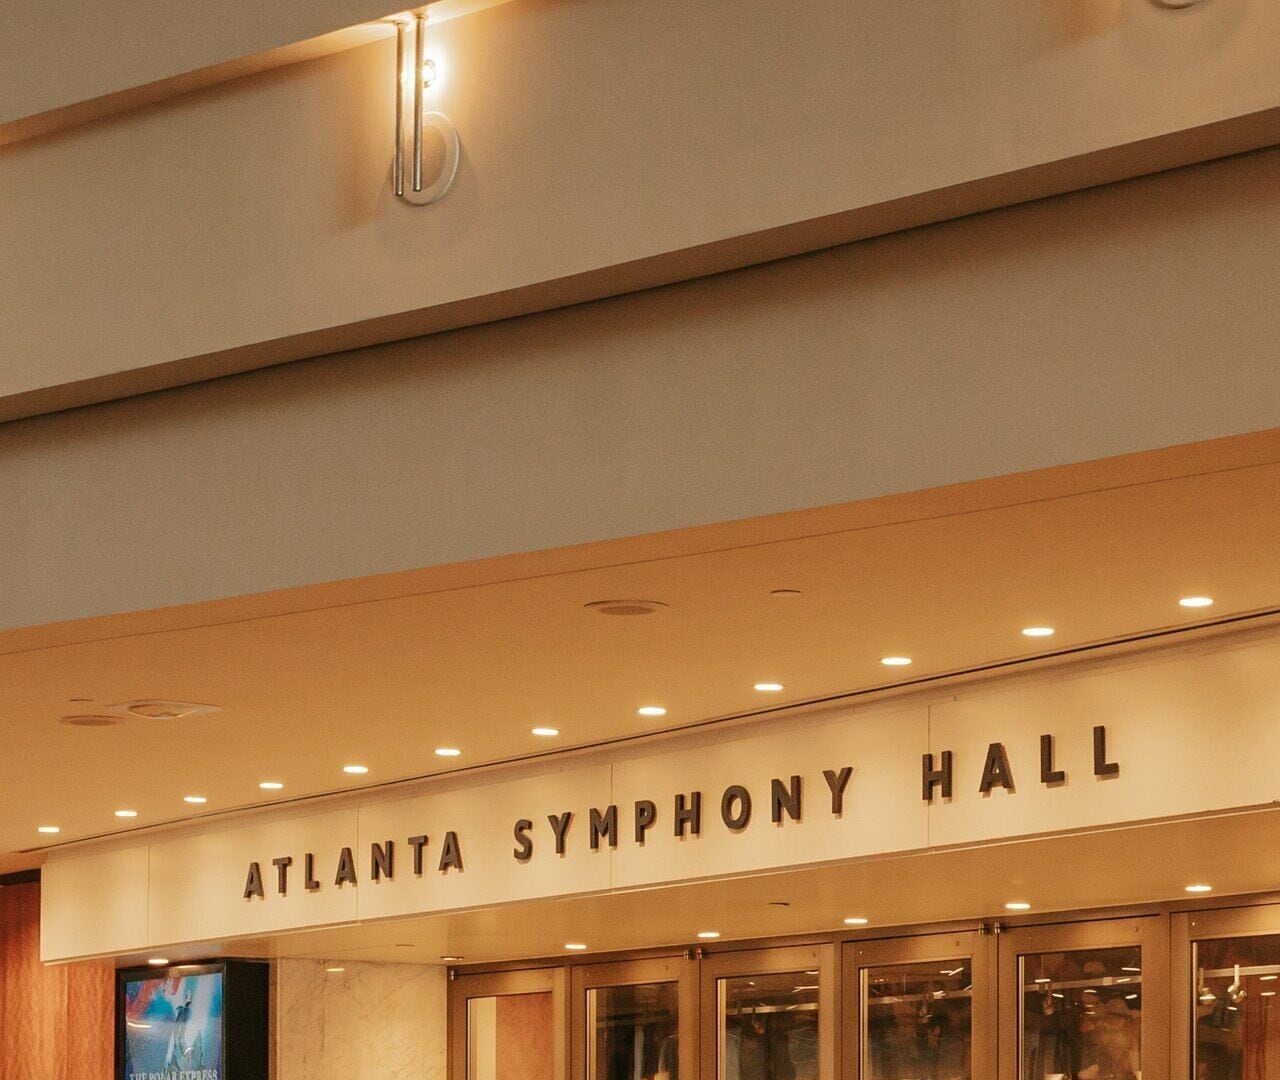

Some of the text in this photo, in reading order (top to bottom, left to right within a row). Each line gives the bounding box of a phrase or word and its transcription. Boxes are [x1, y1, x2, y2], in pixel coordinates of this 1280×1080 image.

[243, 725, 1120, 899] ATLANTA SYMPHONY HALL
